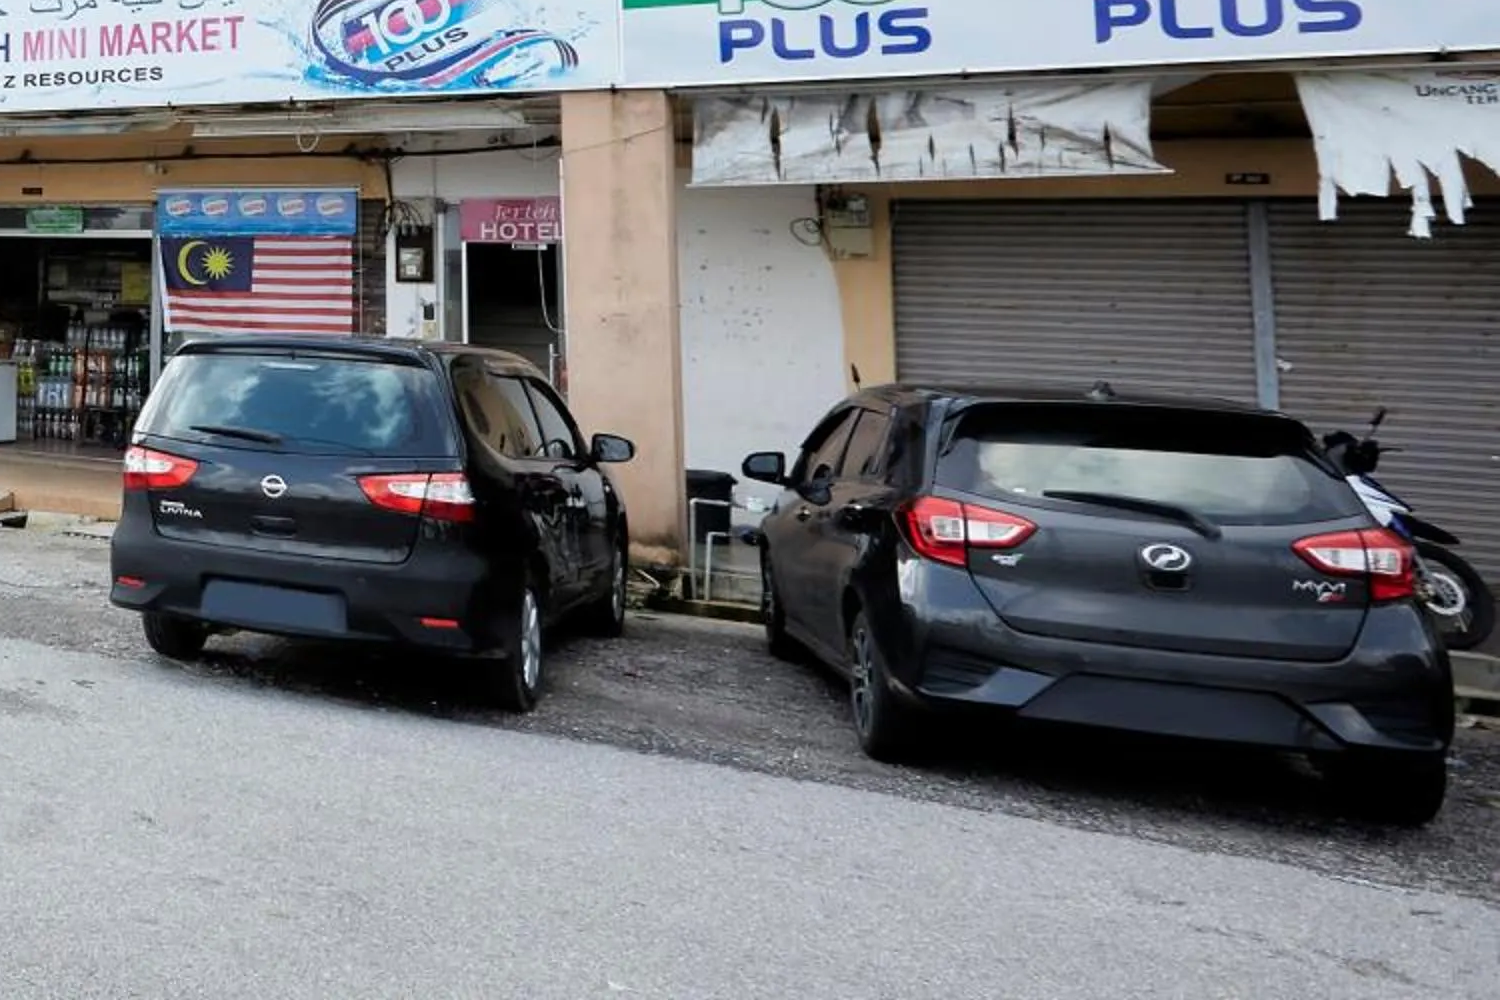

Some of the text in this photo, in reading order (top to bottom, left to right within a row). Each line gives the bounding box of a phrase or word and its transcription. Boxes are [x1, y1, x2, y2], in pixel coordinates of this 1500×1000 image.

[22, 26, 88, 63] MINI
[99, 15, 246, 58] MARKET
[383, 26, 469, 72] PLUS
[718, 7, 932, 64] PLUS
[3, 74, 17, 89] Z
[23, 66, 164, 88] RESOURCES
[480, 221, 562, 241] HOTEL
